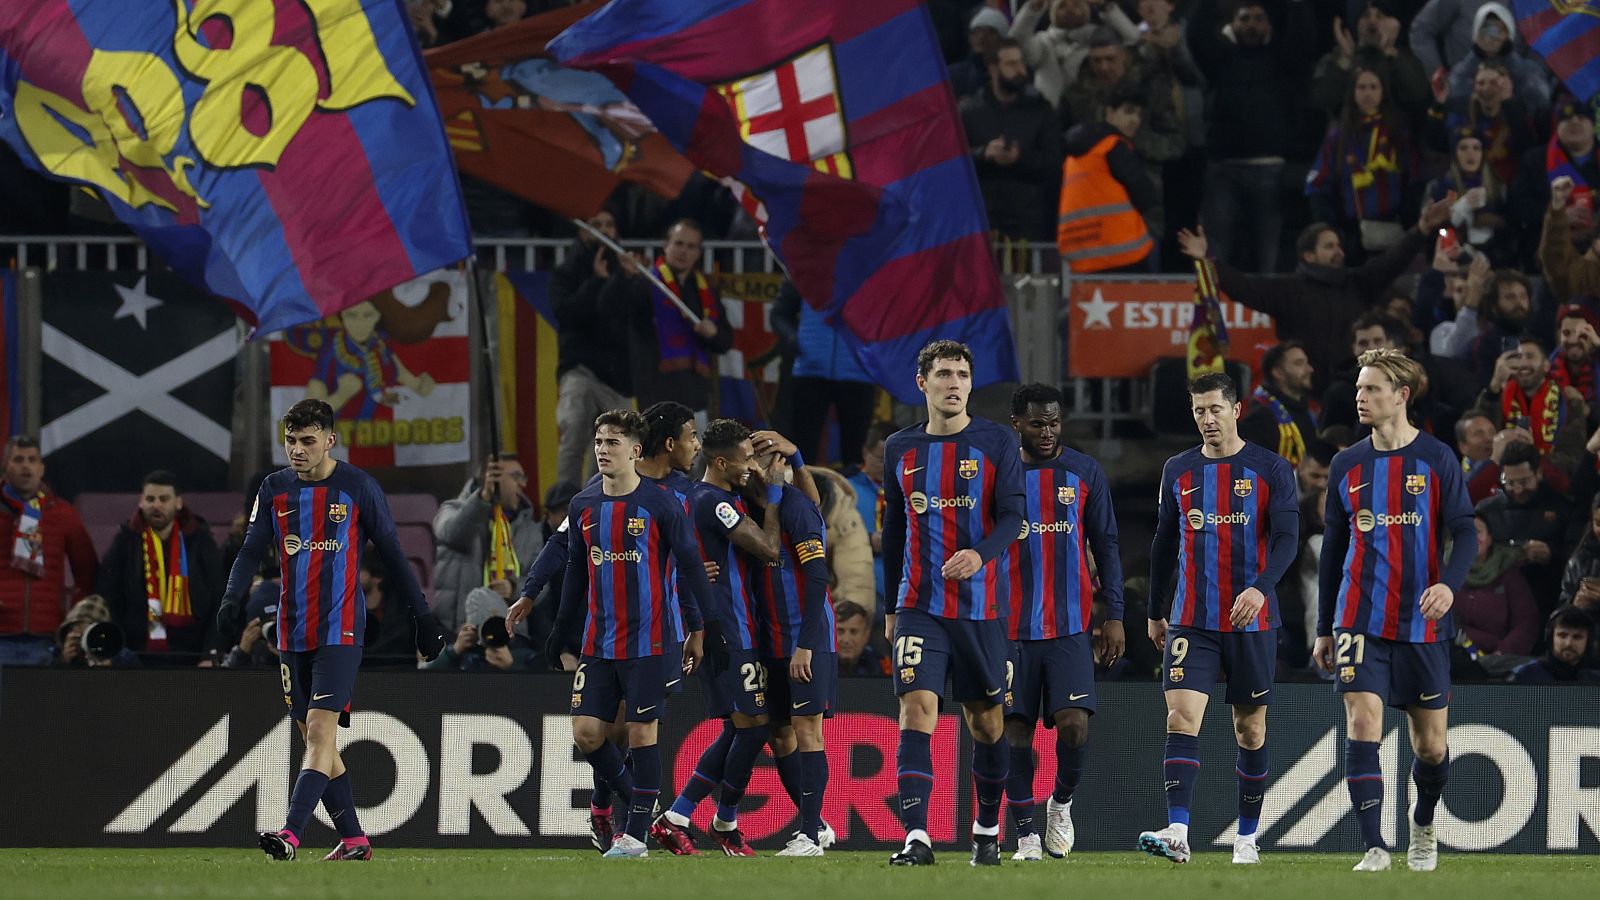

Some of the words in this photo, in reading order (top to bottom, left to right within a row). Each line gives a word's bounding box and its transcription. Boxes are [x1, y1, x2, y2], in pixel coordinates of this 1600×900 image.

[1123, 302, 1271, 328] ESTRLLA
[930, 495, 977, 509] Spotify
[1031, 521, 1074, 534] Spotify
[1206, 513, 1251, 526] Spotify
[1376, 513, 1423, 527] Spotify
[302, 539, 344, 553] Spotify
[604, 550, 643, 563] Spotify
[895, 635, 924, 667] 15
[1170, 637, 1189, 665] 9
[1337, 633, 1366, 665] 21
[573, 663, 587, 691] 6
[673, 712, 1060, 843] GRI
